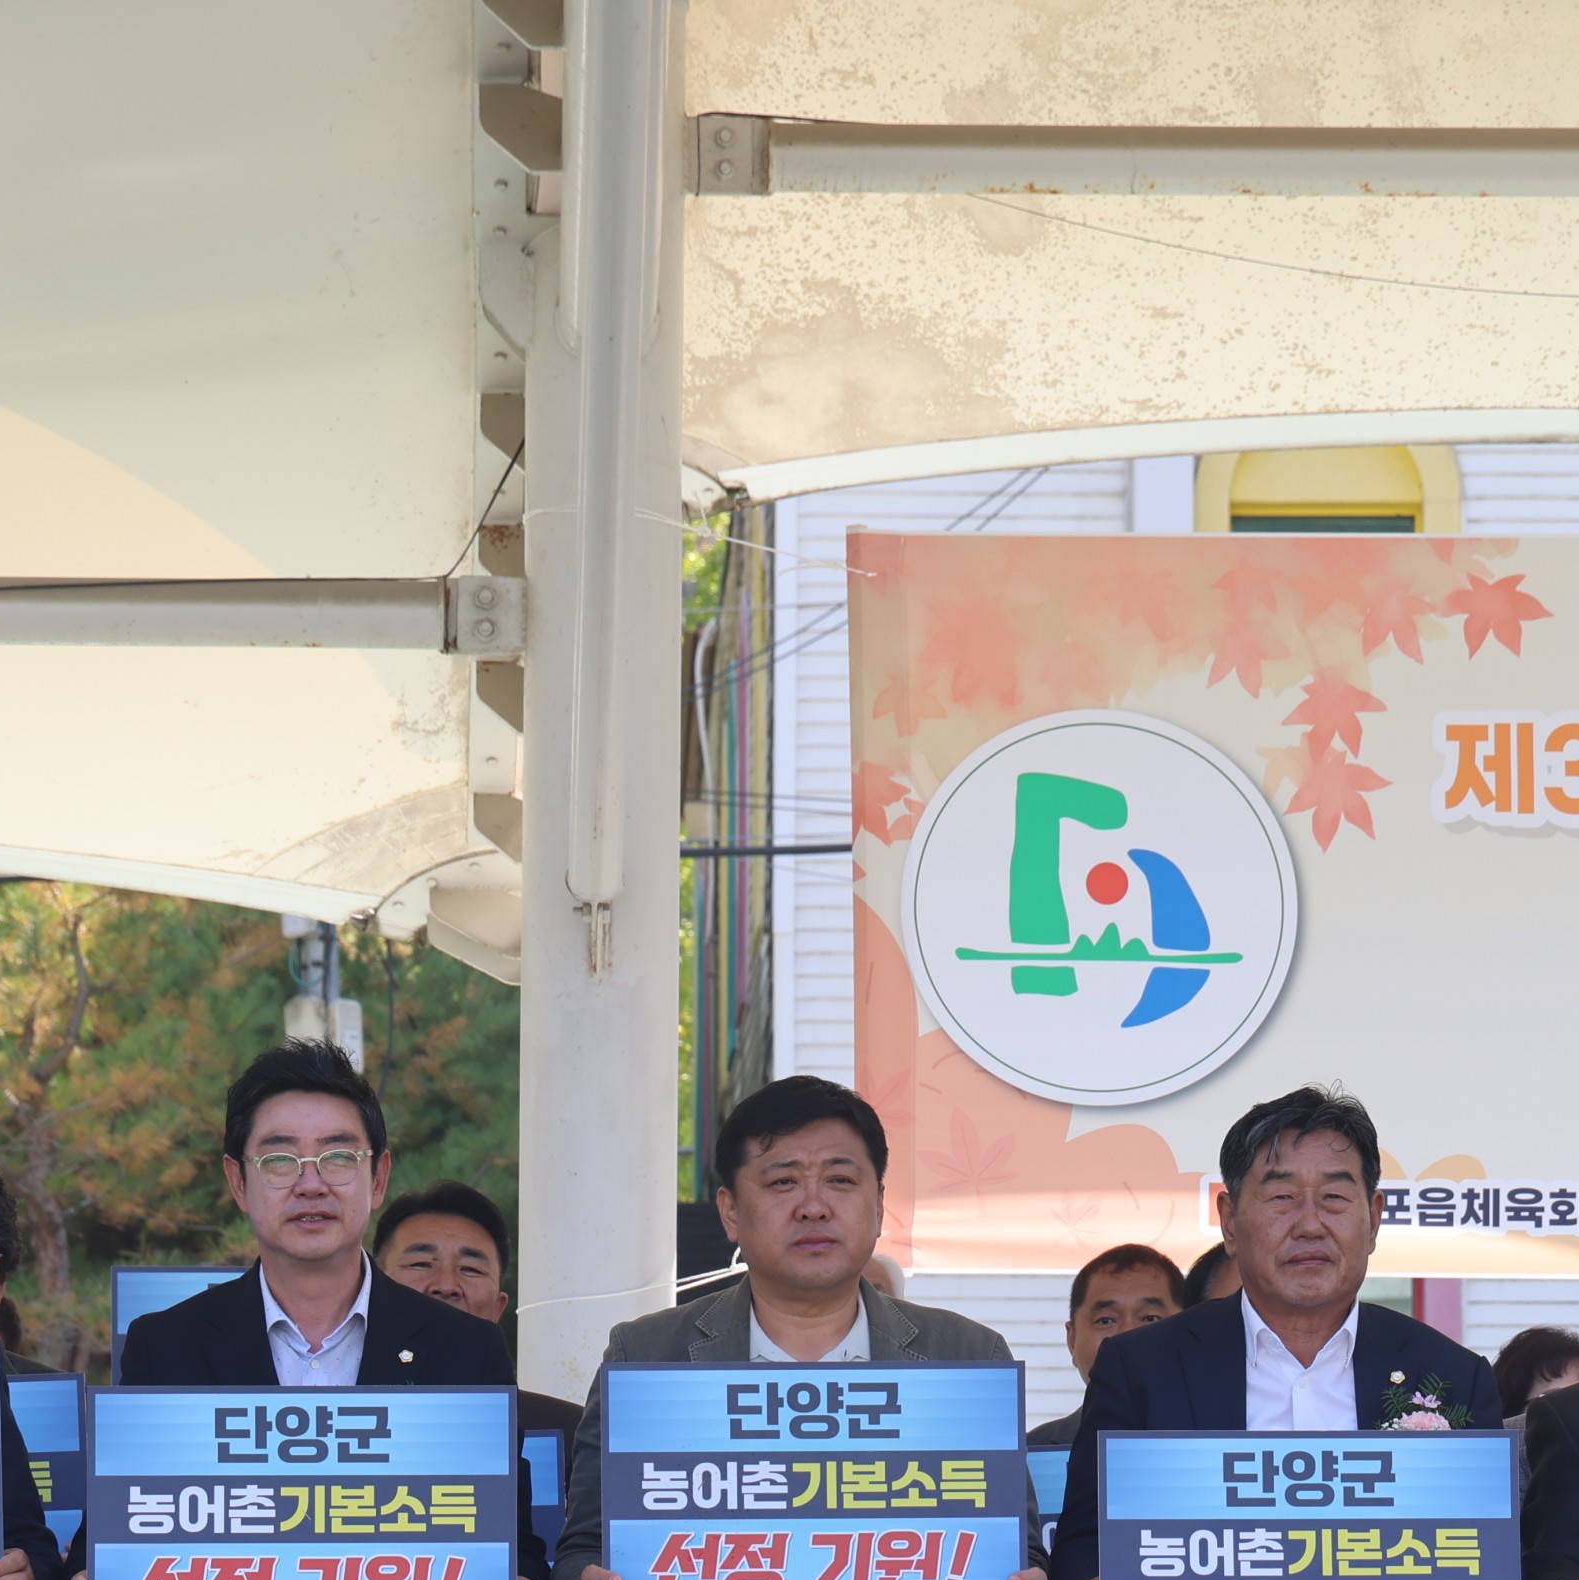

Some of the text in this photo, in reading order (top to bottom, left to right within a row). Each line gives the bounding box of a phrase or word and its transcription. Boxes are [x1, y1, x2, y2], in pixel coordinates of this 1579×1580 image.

[214, 1405, 392, 1464] 단양군
[726, 1382, 902, 1440] 단양군
[1222, 1450, 1396, 1507] 단양군
